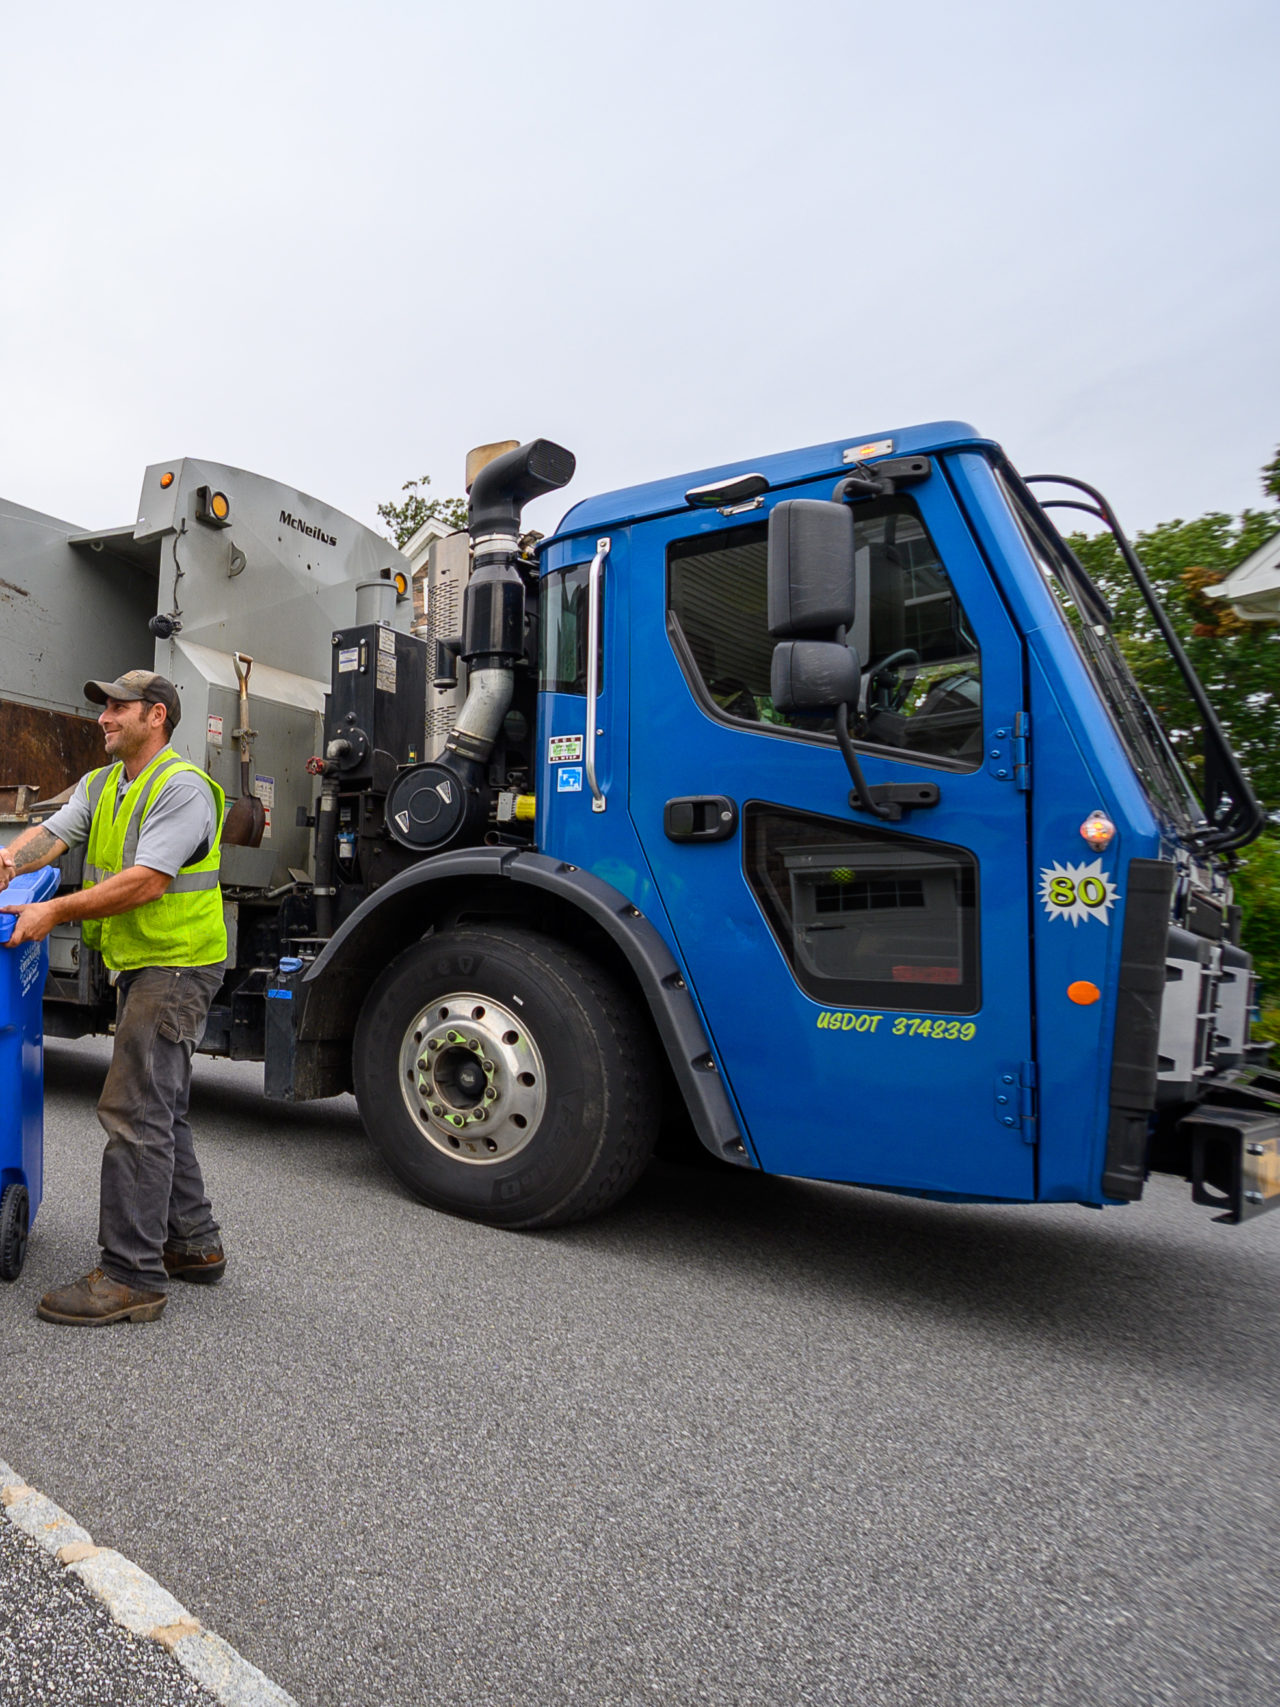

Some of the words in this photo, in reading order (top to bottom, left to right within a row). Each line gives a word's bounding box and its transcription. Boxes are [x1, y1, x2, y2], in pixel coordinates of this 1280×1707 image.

[279, 509, 338, 547] McNeilus
[1048, 876, 1107, 908] 80
[816, 1011, 883, 1033] USDOT
[892, 1017, 977, 1041] 374839
